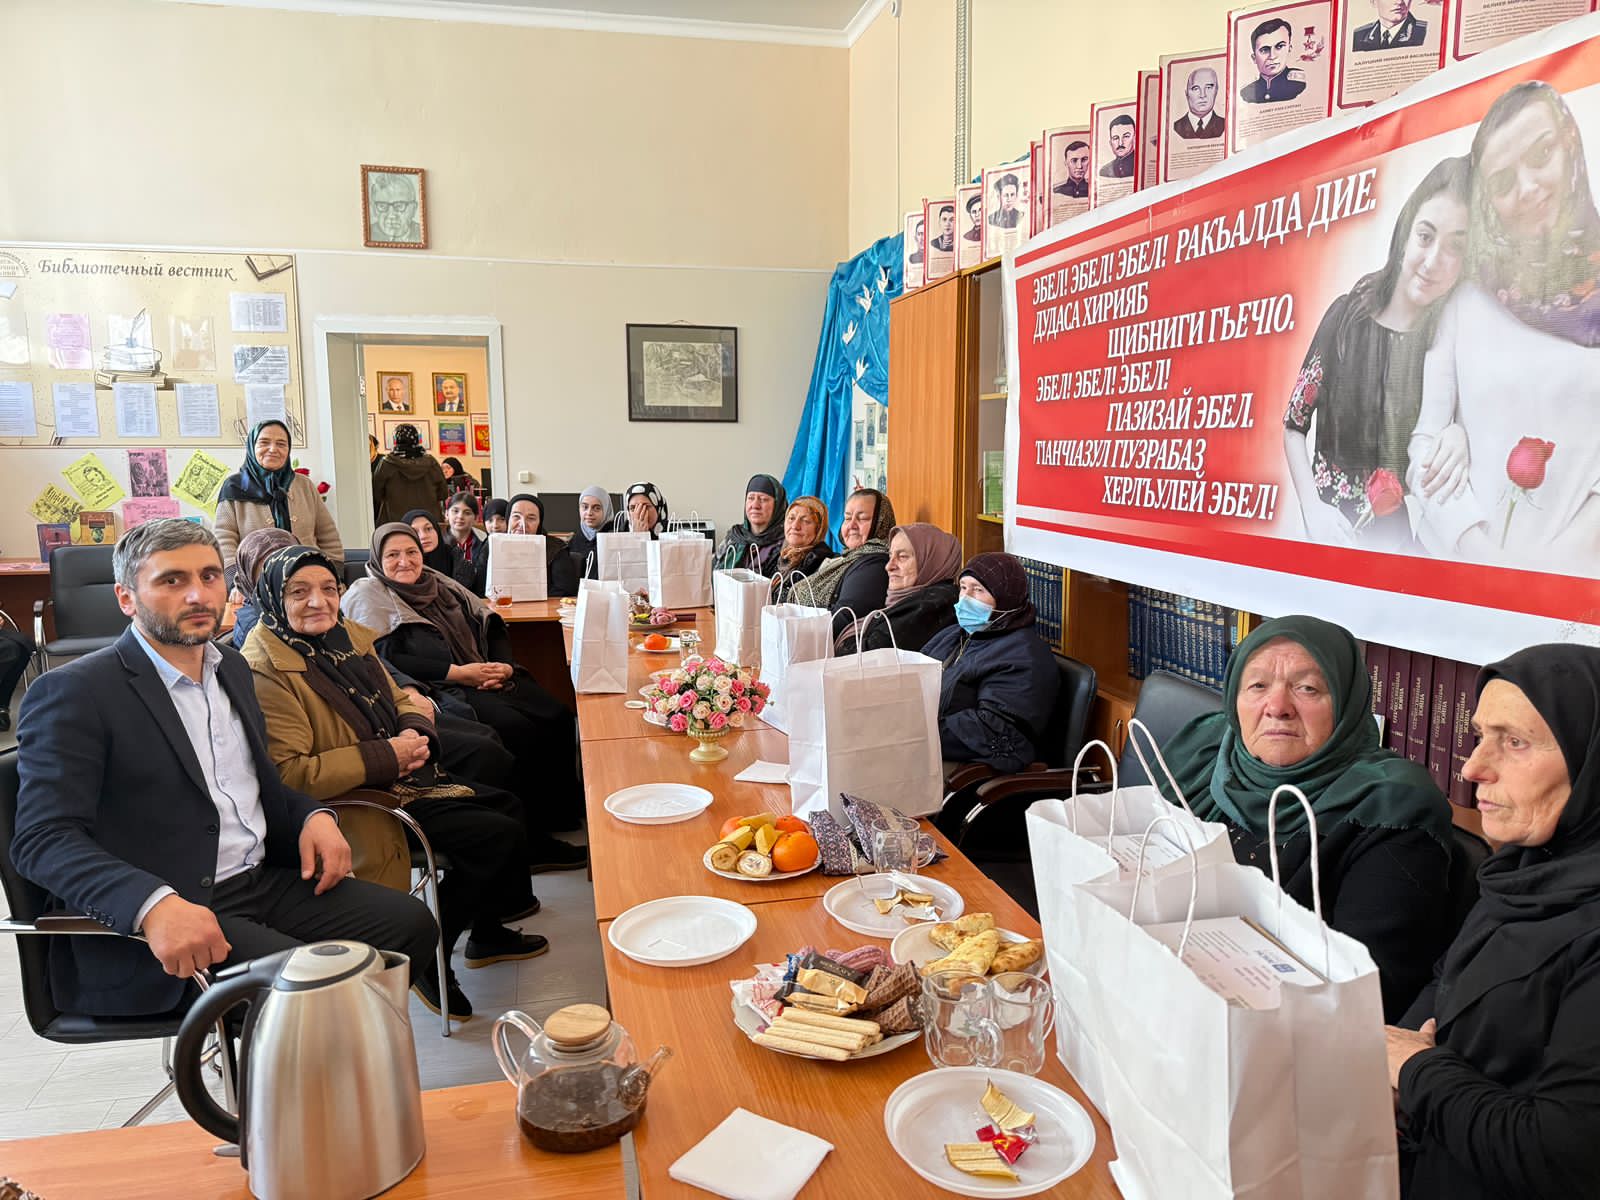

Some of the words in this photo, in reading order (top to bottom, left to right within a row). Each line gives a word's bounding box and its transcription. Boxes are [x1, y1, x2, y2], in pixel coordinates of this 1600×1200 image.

[1032, 268, 1069, 305] ЭБЕЛ!
[1071, 252, 1115, 295] ЭБЕЛ!
[1116, 234, 1169, 281] ЭБЕЛ!
[1306, 167, 1377, 239] ДИЕ.
[37, 257, 164, 277] Библиотечный
[168, 264, 238, 282] вестник
[1033, 300, 1081, 345] ДУДАСА
[1082, 281, 1149, 327] ХИРИЯБ
[1107, 310, 1206, 363] ЩИБНИГИ
[1036, 372, 1072, 402] ЭБЕЛ!
[1073, 367, 1117, 398] ЭБЕЛ!
[1118, 358, 1172, 394] ЭБЕЛ!
[1194, 392, 1254, 430] ЭБЕЛ.
[1207, 481, 1280, 521] ЭБЕЛ!
